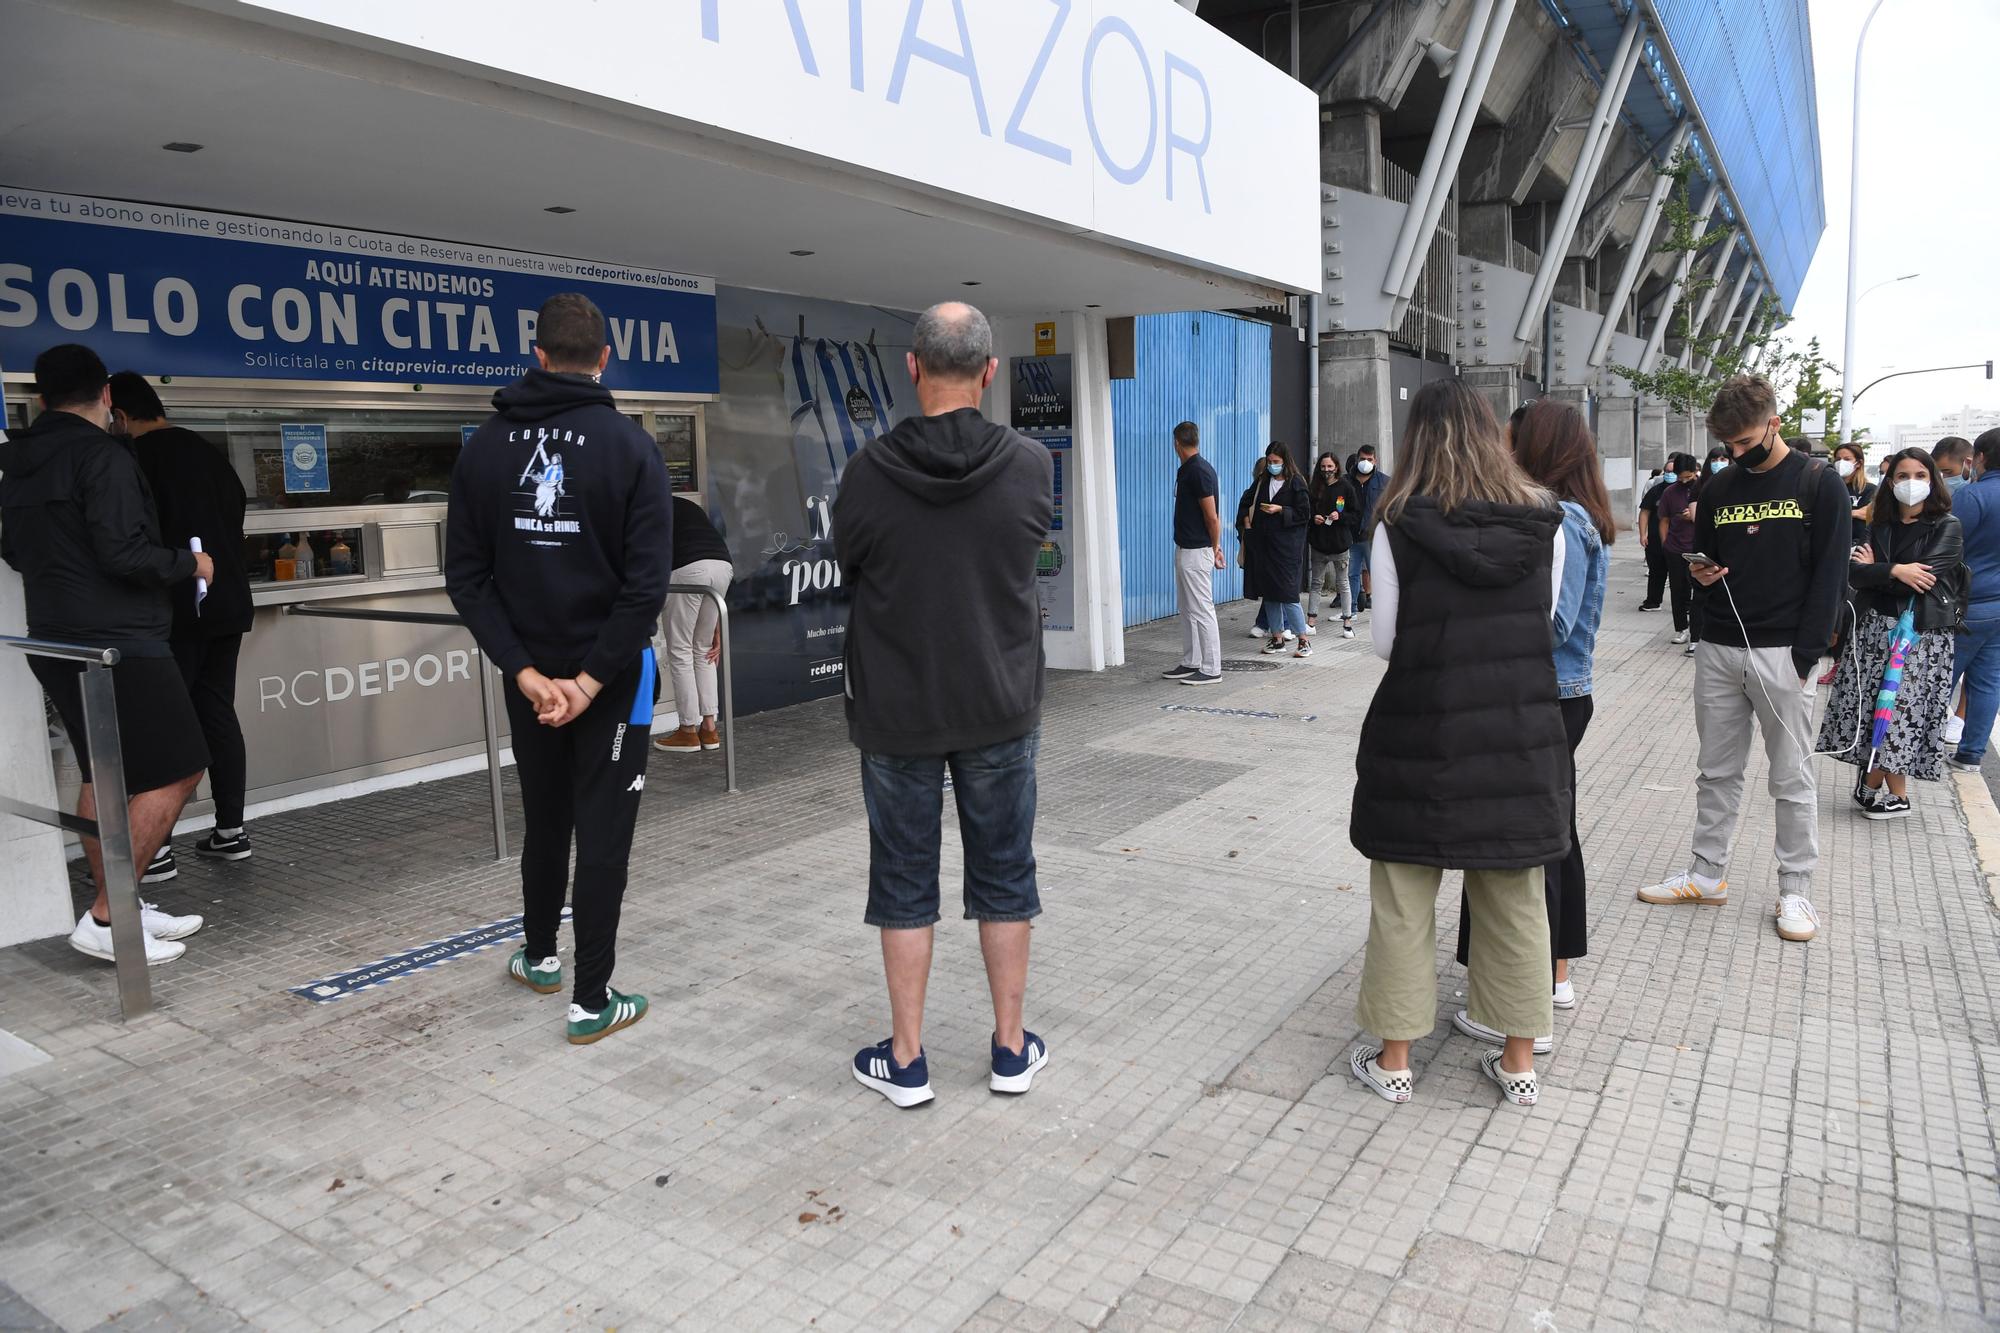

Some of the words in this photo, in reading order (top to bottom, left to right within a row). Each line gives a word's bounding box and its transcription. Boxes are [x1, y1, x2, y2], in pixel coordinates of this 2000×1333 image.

[701, 0, 1212, 215] AZOR
[0, 194, 41, 211] eva
[50, 199, 71, 214] tu
[80, 202, 144, 223] abono
[151, 211, 210, 231] online
[216, 220, 324, 244] gestionando
[330, 231, 342, 246] la
[348, 234, 392, 253] Cuota
[398, 241, 415, 255] de
[421, 244, 473, 263] Reserva
[478, 254, 494, 264] en
[498, 255, 543, 270] nuestra
[549, 261, 573, 274] web
[576, 264, 699, 289] rcdeportivo.es/abonos
[305, 260, 362, 287] AQUÍ
[368, 266, 495, 298] ATENDEMOS
[0, 262, 199, 337] SOLO
[227, 283, 359, 346] CON
[381, 297, 501, 354] CITA
[517, 308, 681, 364] PVIA
[245, 352, 329, 369] Solicítala
[335, 358, 356, 371] en
[361, 357, 529, 378] citaprevia.rcdeportiv
[514, 517, 544, 532] NUNCA
[554, 520, 581, 533] RINDE
[806, 627, 827, 639] Mucho
[810, 662, 844, 676] rcdepo
[611, 722, 627, 762] Kappa
[346, 959, 412, 986] AGARDE
[413, 945, 452, 963] AQUÍ
[495, 921, 524, 934] QUE
